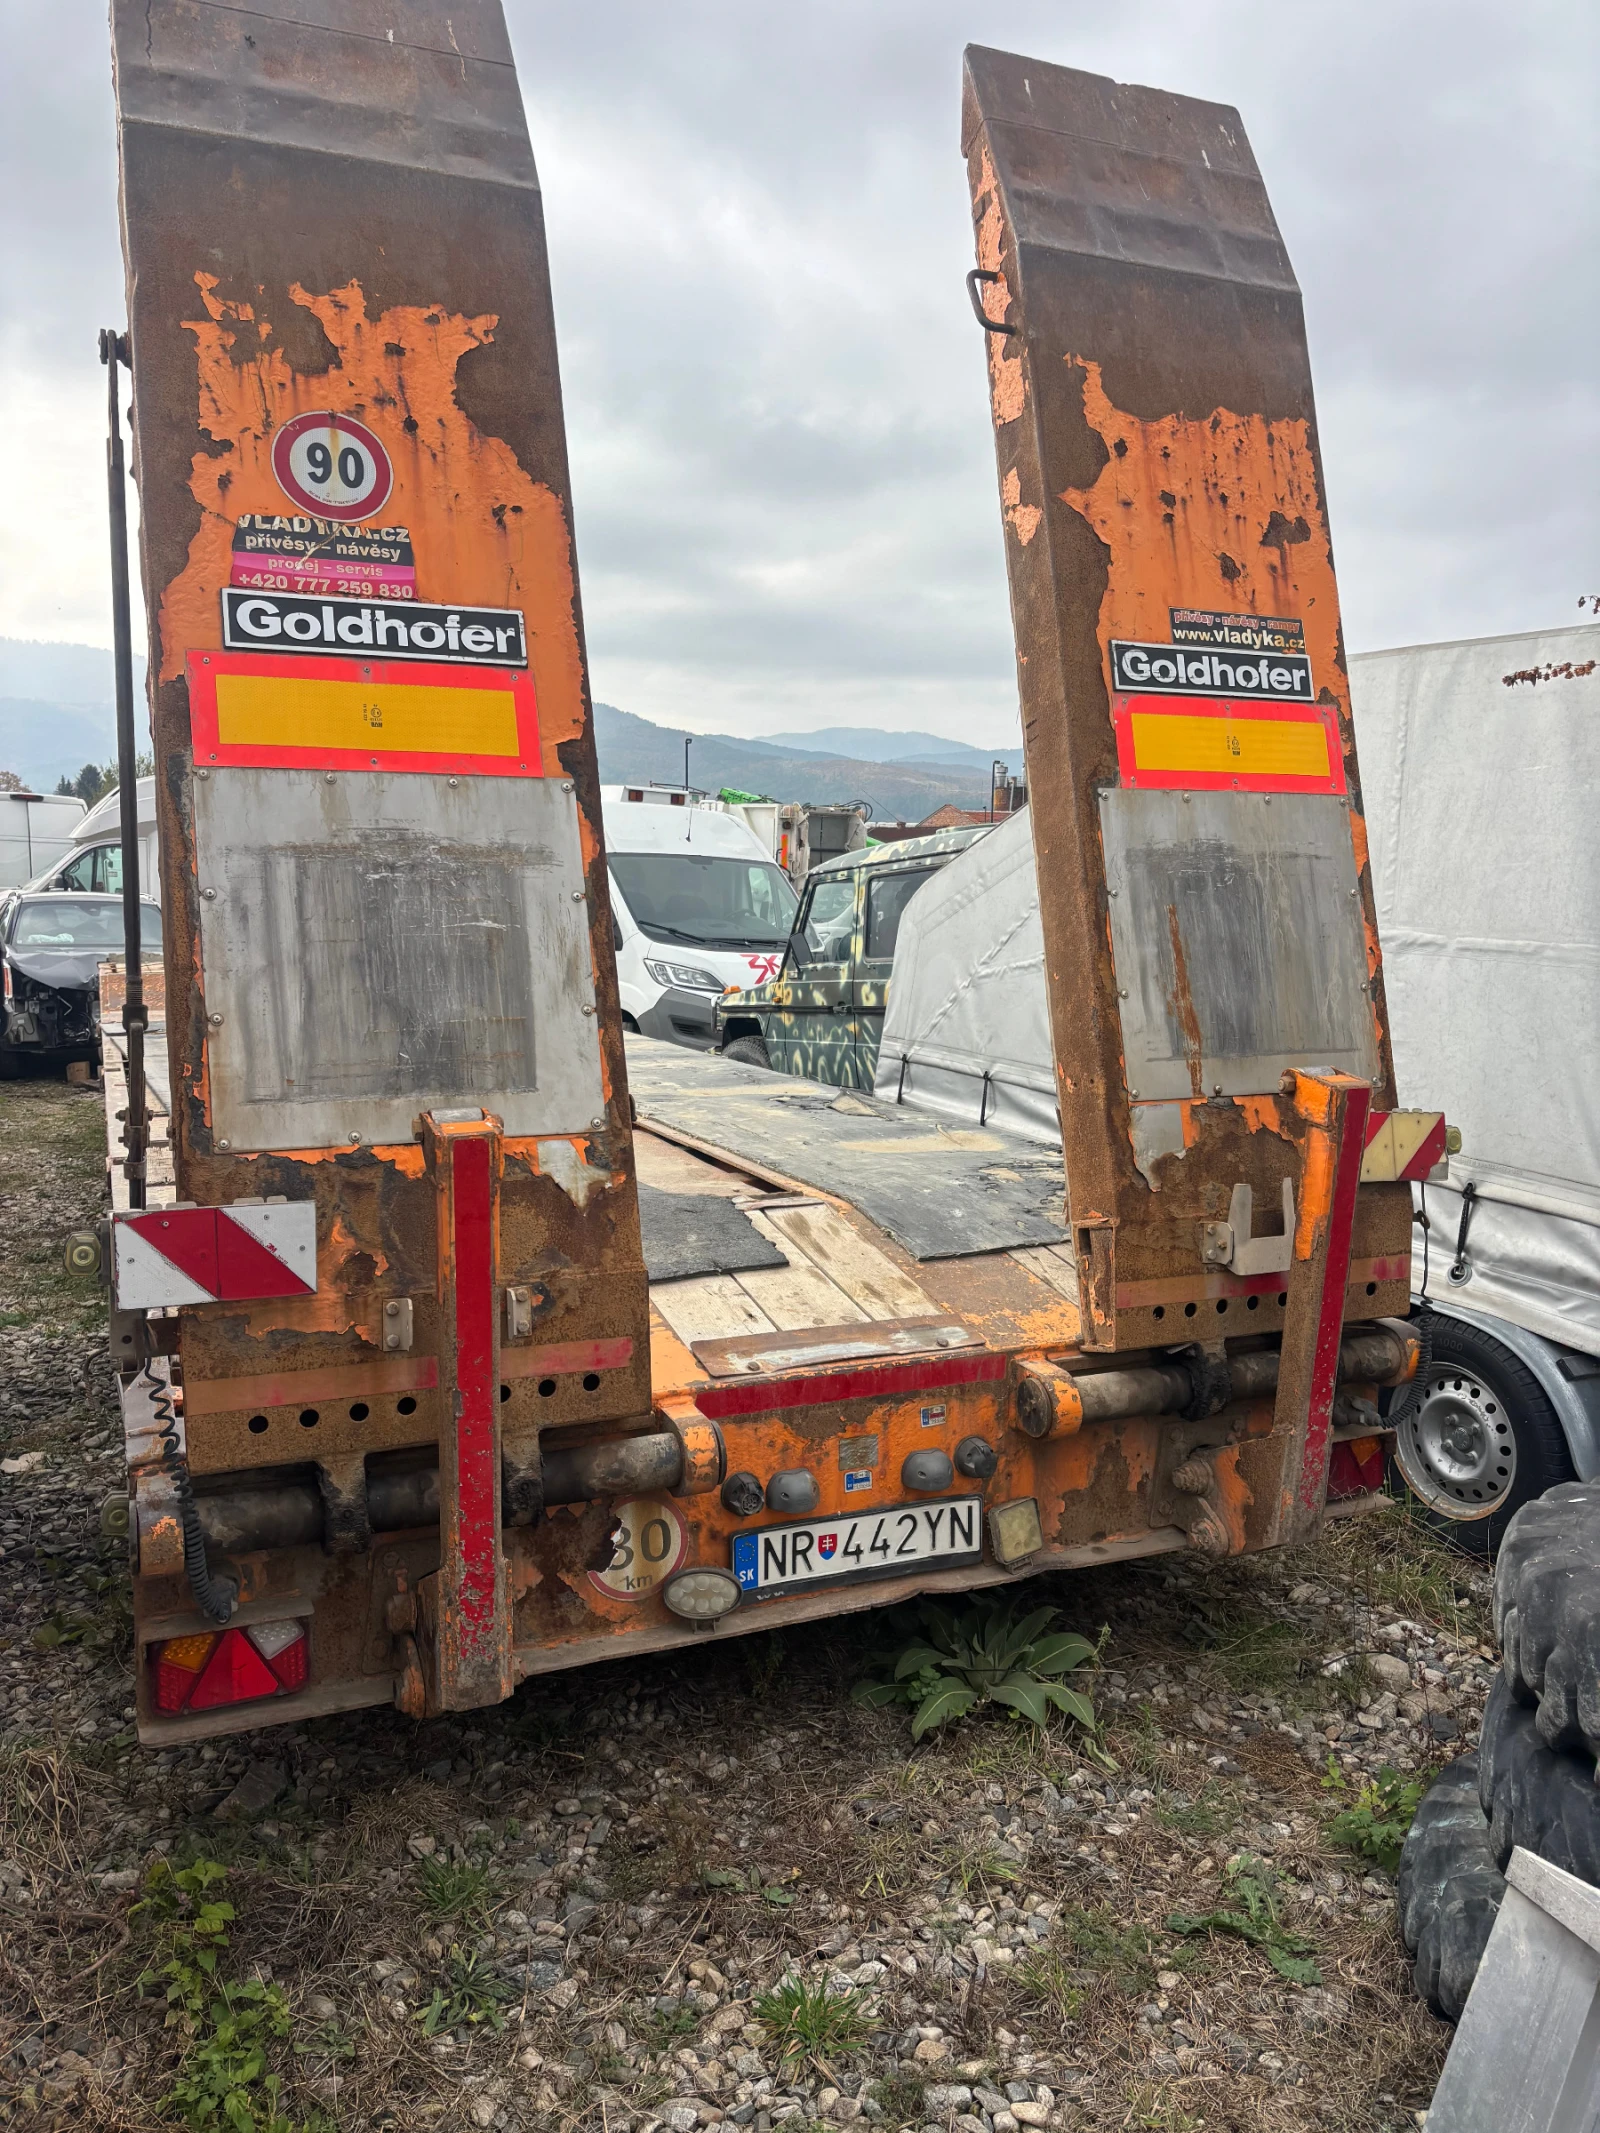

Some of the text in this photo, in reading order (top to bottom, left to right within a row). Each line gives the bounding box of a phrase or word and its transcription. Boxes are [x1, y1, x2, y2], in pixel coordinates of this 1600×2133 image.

[307, 442, 364, 489] 90
[245, 533, 316, 552] přívěsy
[336, 542, 401, 562] návěsy
[336, 562, 383, 577] servis
[239, 573, 413, 599] +420 777 259 830
[236, 600, 516, 653] Goldhofer
[1174, 610, 1214, 627] přívěsy
[1222, 615, 1259, 632] návěsy
[1267, 619, 1300, 634] rampy
[1173, 627, 1305, 650] www.vladyka.cz
[1121, 649, 1306, 691] Goldhofer
[764, 1505, 974, 1580] NR 442YN
[626, 1574, 653, 1591] km
[739, 1568, 755, 1582] SK
